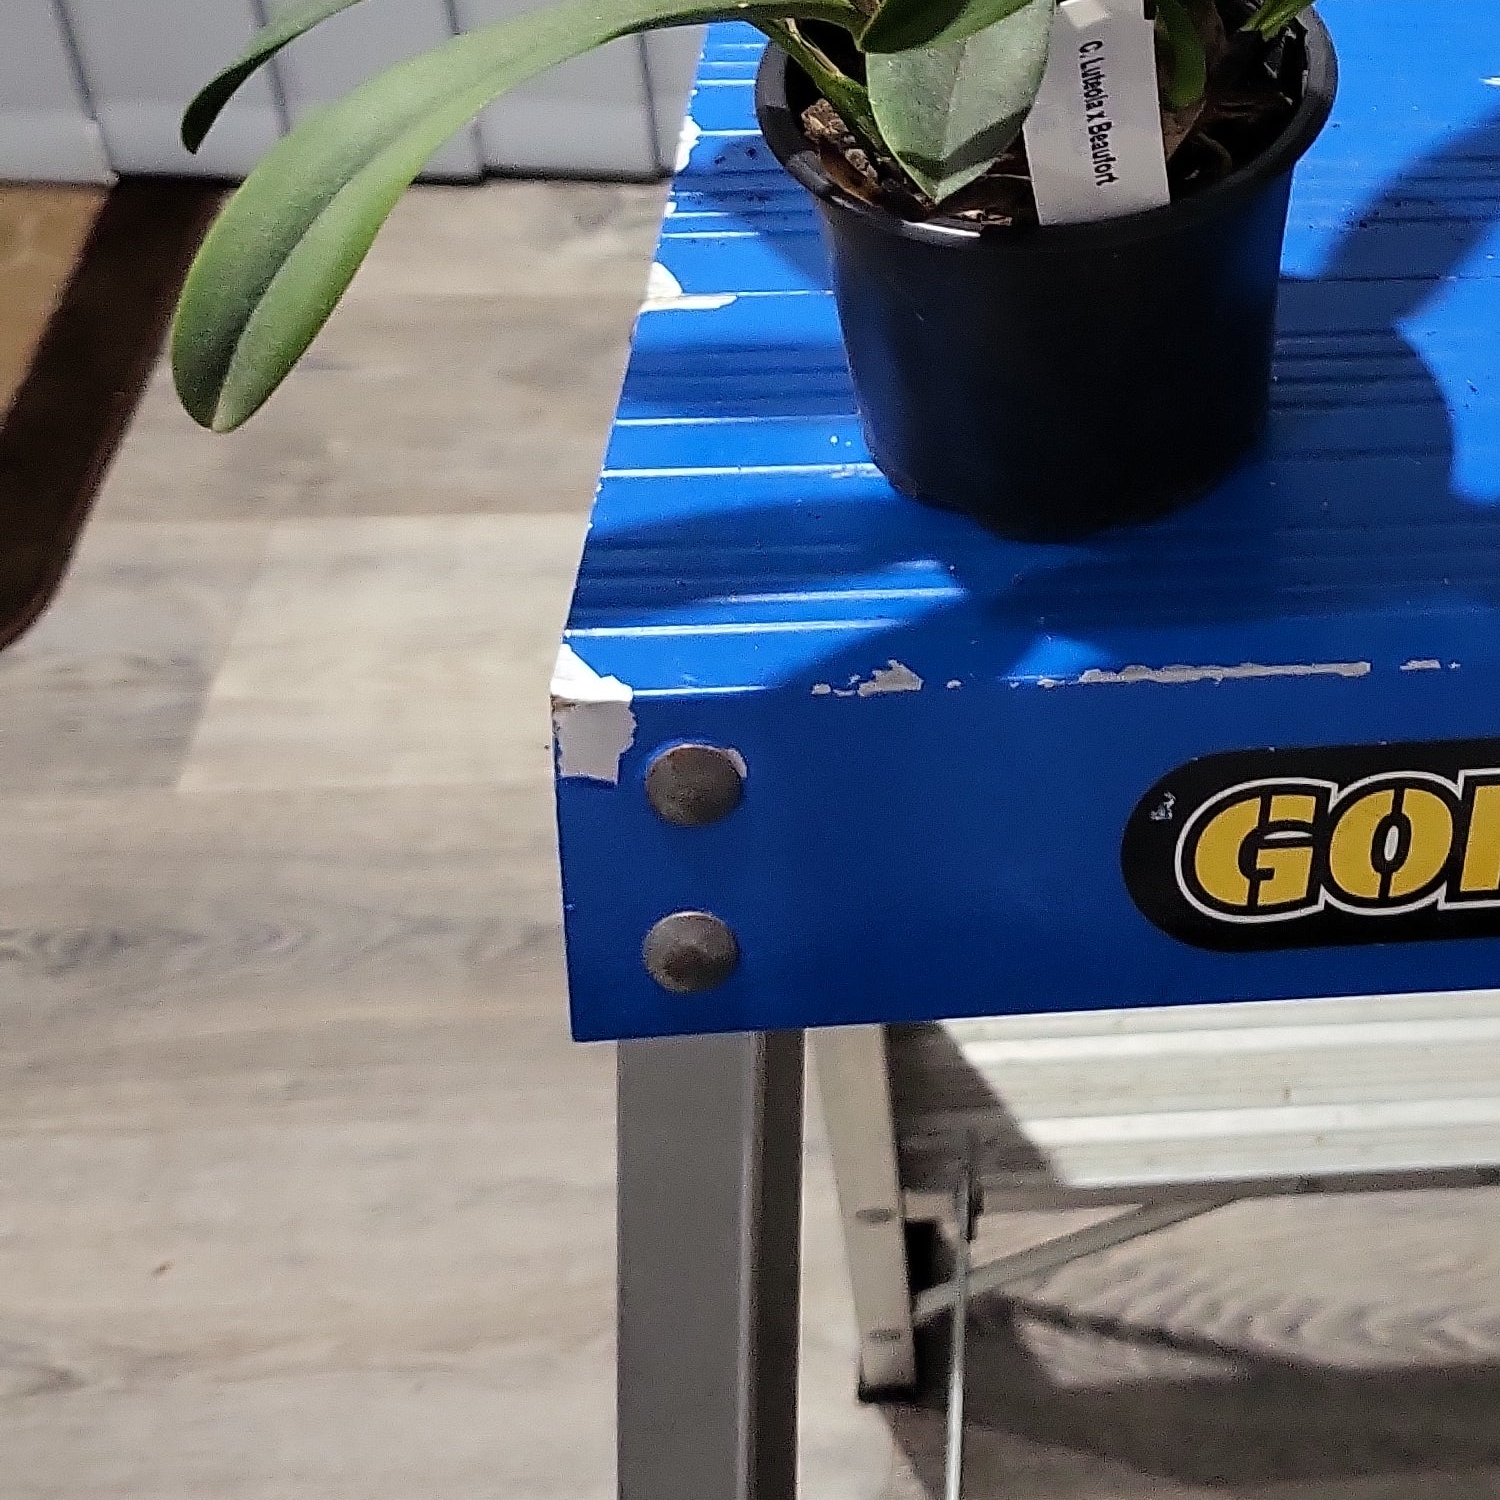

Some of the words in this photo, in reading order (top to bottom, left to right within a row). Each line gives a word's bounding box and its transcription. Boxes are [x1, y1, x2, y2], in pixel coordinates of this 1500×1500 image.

[1079, 40, 1104, 59] C.
[1080, 56, 1109, 112] Luteola
[1086, 111, 1105, 123] x
[1088, 121, 1120, 187] Beaufort
